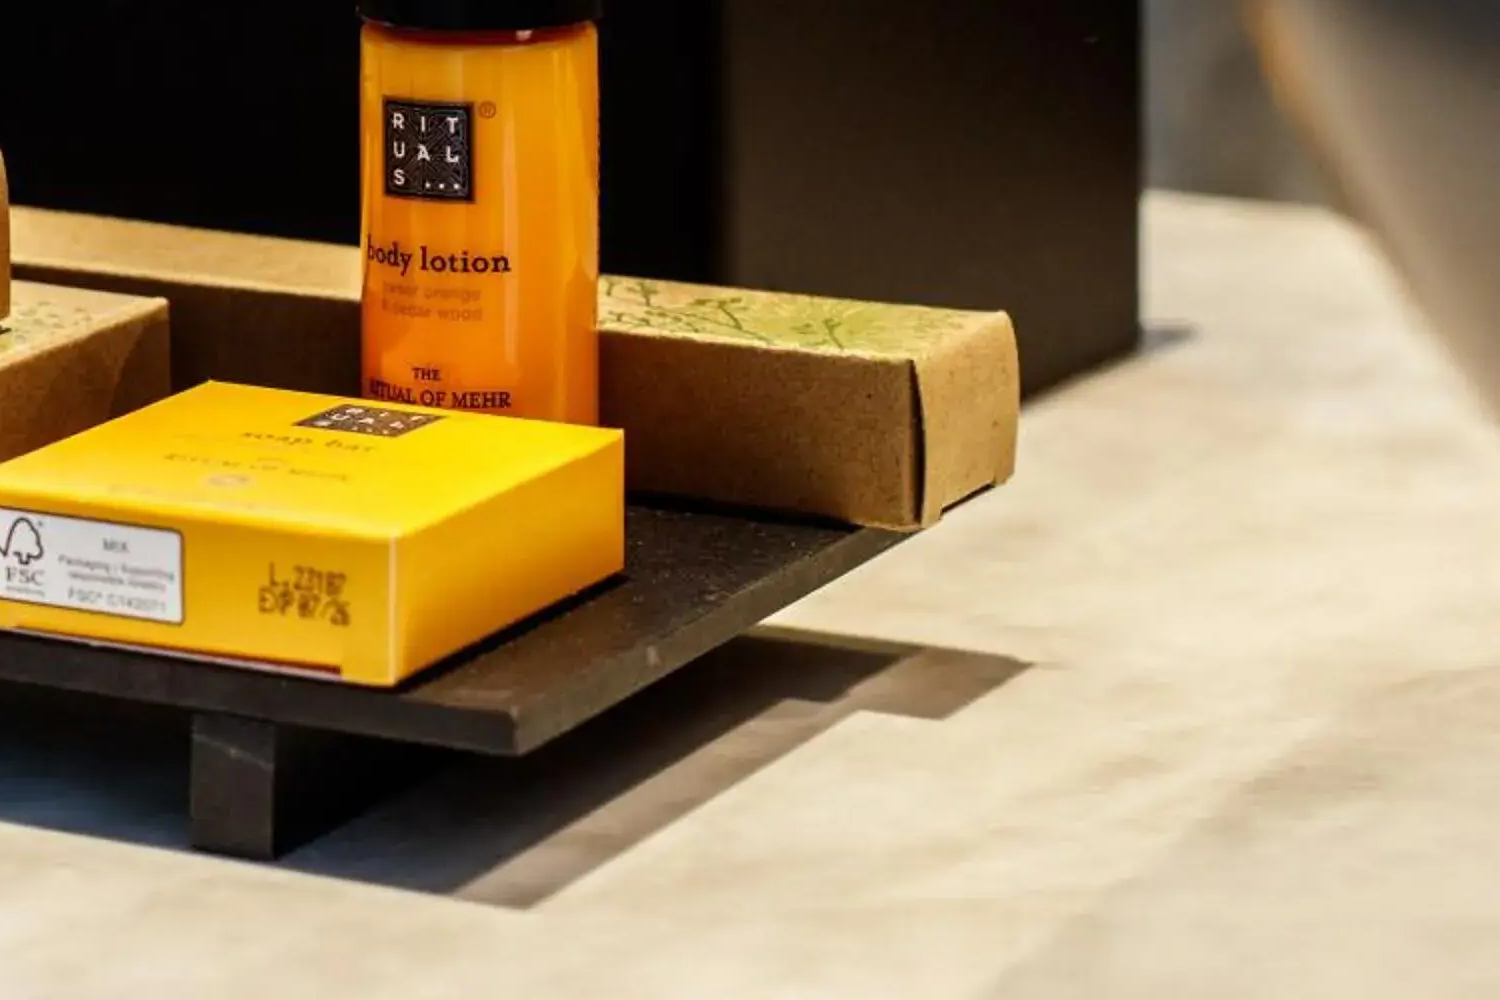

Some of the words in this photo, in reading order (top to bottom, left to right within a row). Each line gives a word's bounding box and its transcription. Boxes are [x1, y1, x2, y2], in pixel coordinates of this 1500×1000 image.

[367, 234, 412, 276] body
[420, 245, 511, 274] lotion
[412, 367, 441, 381] THE
[420, 389, 446, 407] OF
[452, 391, 511, 409] MEHR
[5, 566, 46, 586] FSC
